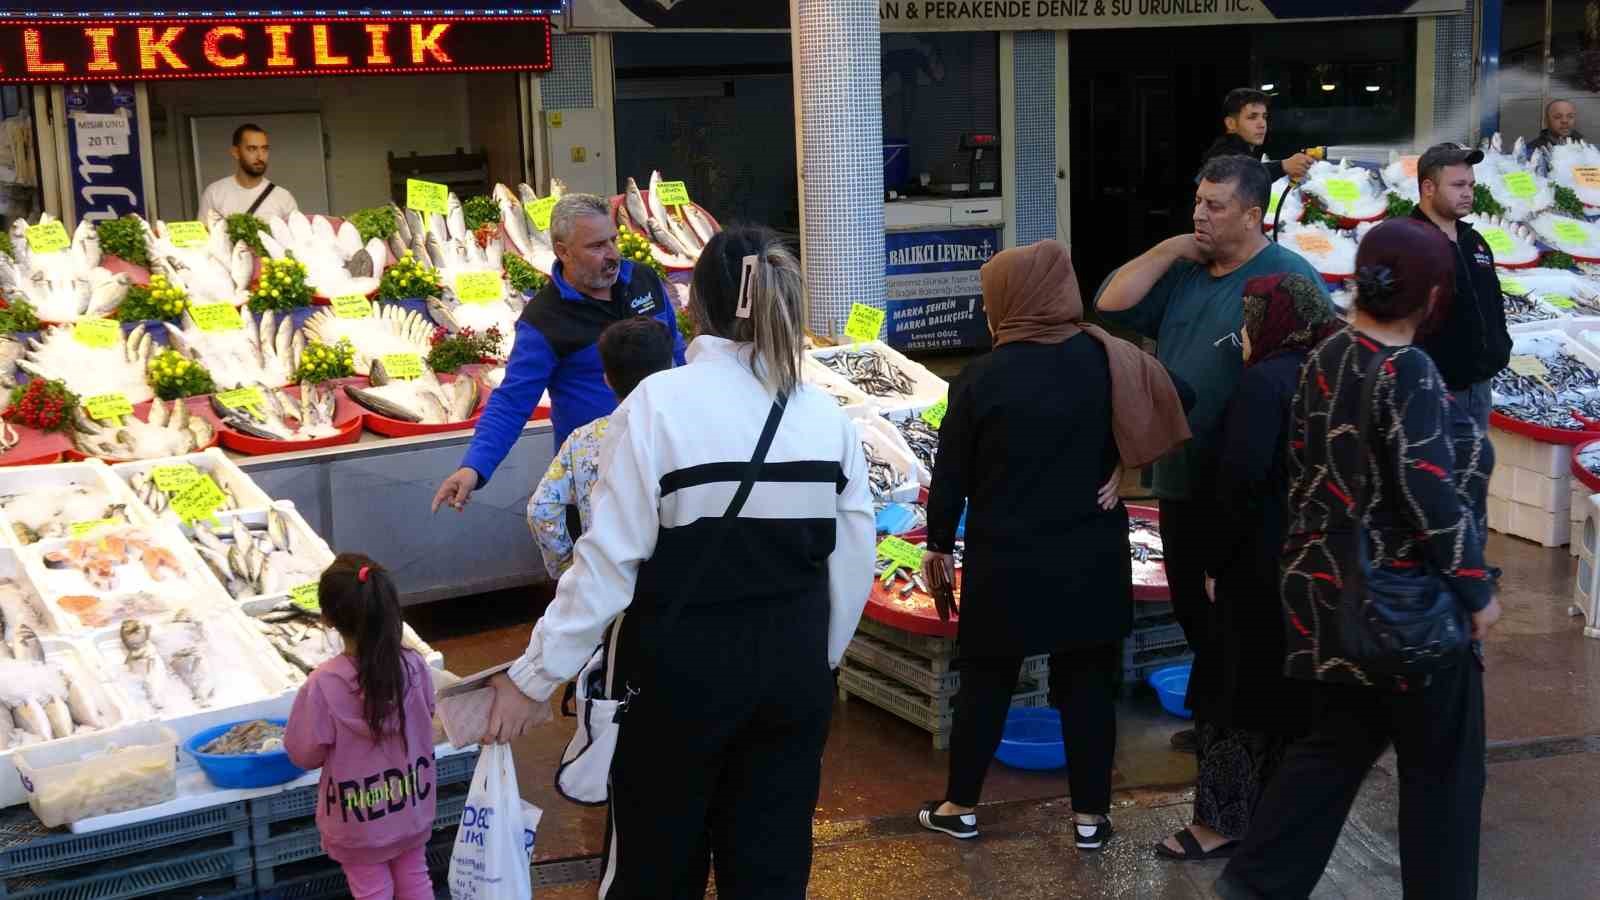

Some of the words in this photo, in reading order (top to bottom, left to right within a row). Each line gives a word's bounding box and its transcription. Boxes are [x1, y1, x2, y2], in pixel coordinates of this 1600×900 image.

[906, 2, 919, 20] &
[925, 1, 1031, 19] PERAKENDE
[1094, 0, 1106, 16] &
[1111, 0, 1133, 16] SU
[0, 22, 453, 72] LIKCILIK
[88, 136, 102, 146] 20
[103, 135, 117, 146] TL
[936, 244, 979, 262] LEVENT
[893, 306, 924, 321] MARKA
[896, 318, 926, 332] MARKA
